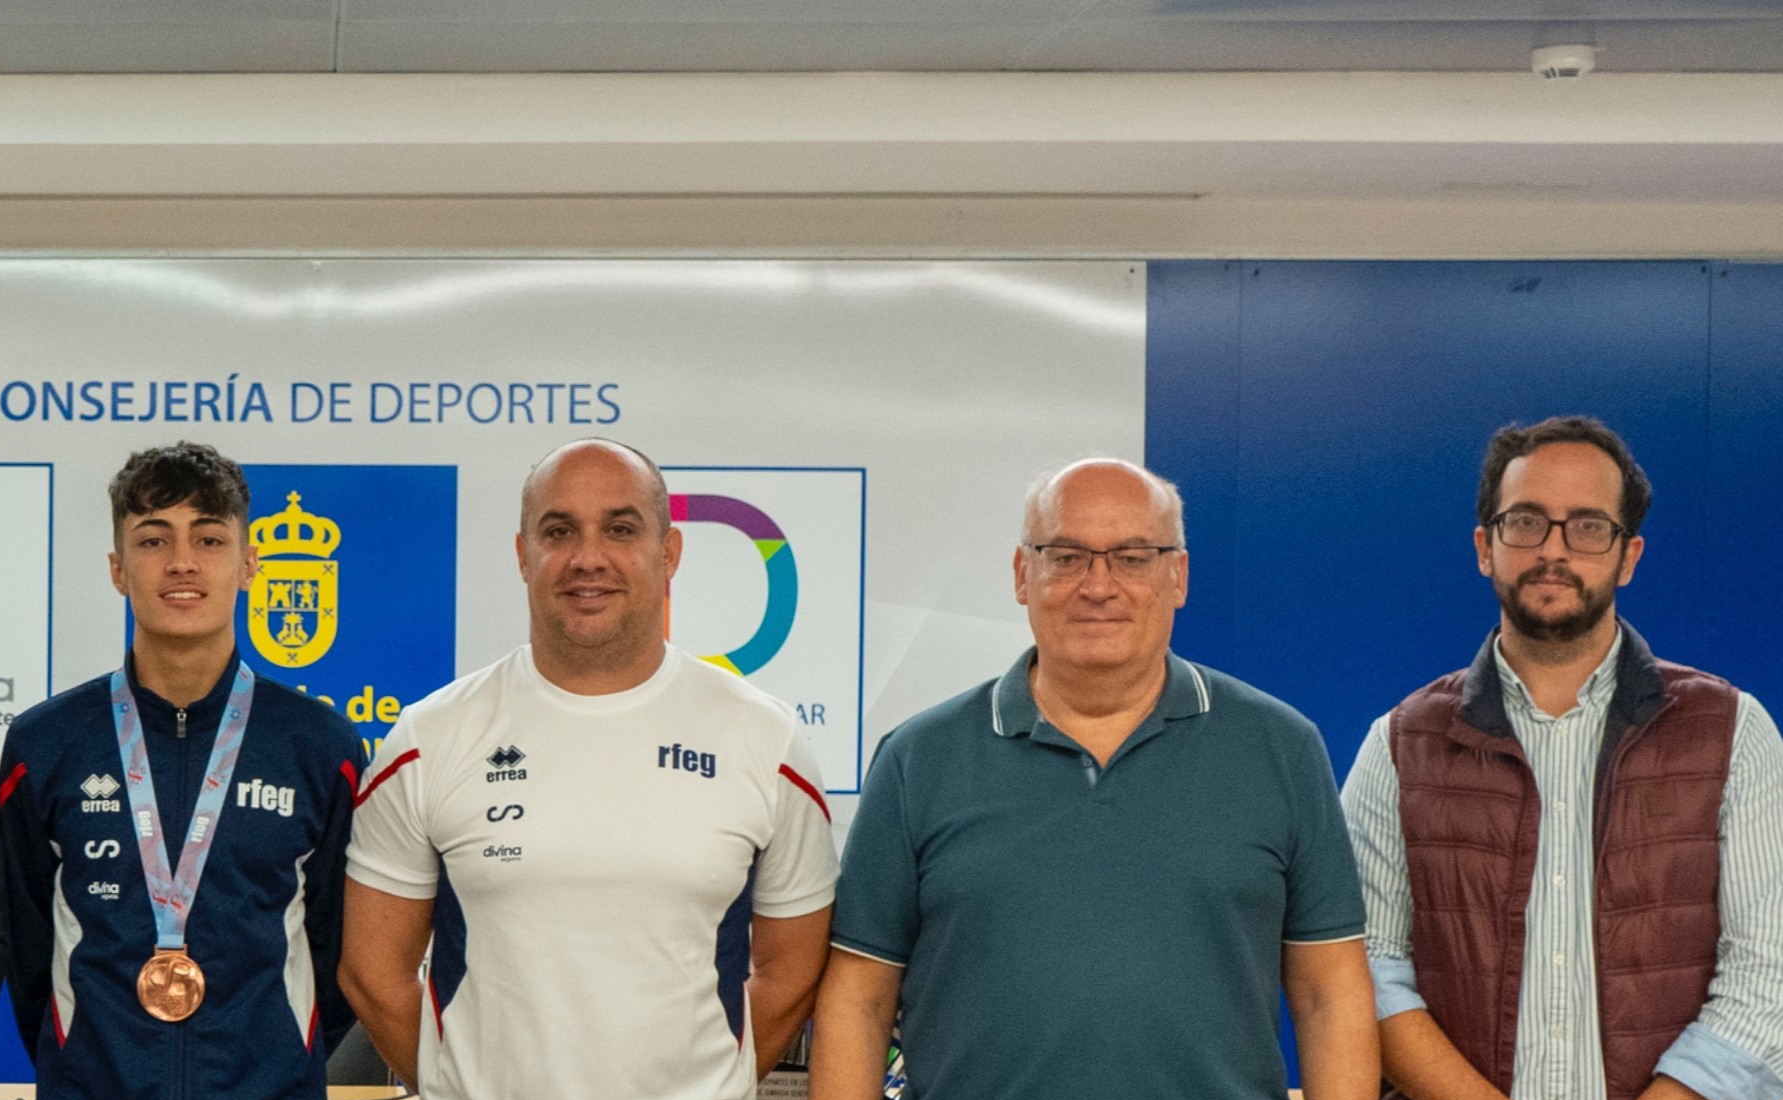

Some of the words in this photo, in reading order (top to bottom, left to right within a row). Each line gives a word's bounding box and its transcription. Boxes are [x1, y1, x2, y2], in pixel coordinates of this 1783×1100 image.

[290, 383, 352, 423] DE
[370, 383, 621, 424] DEPORTES
[658, 743, 716, 779] rfeg
[486, 768, 527, 783] errea
[81, 799, 120, 813] errea
[237, 778, 295, 818] rfeg
[483, 844, 522, 857] divina
